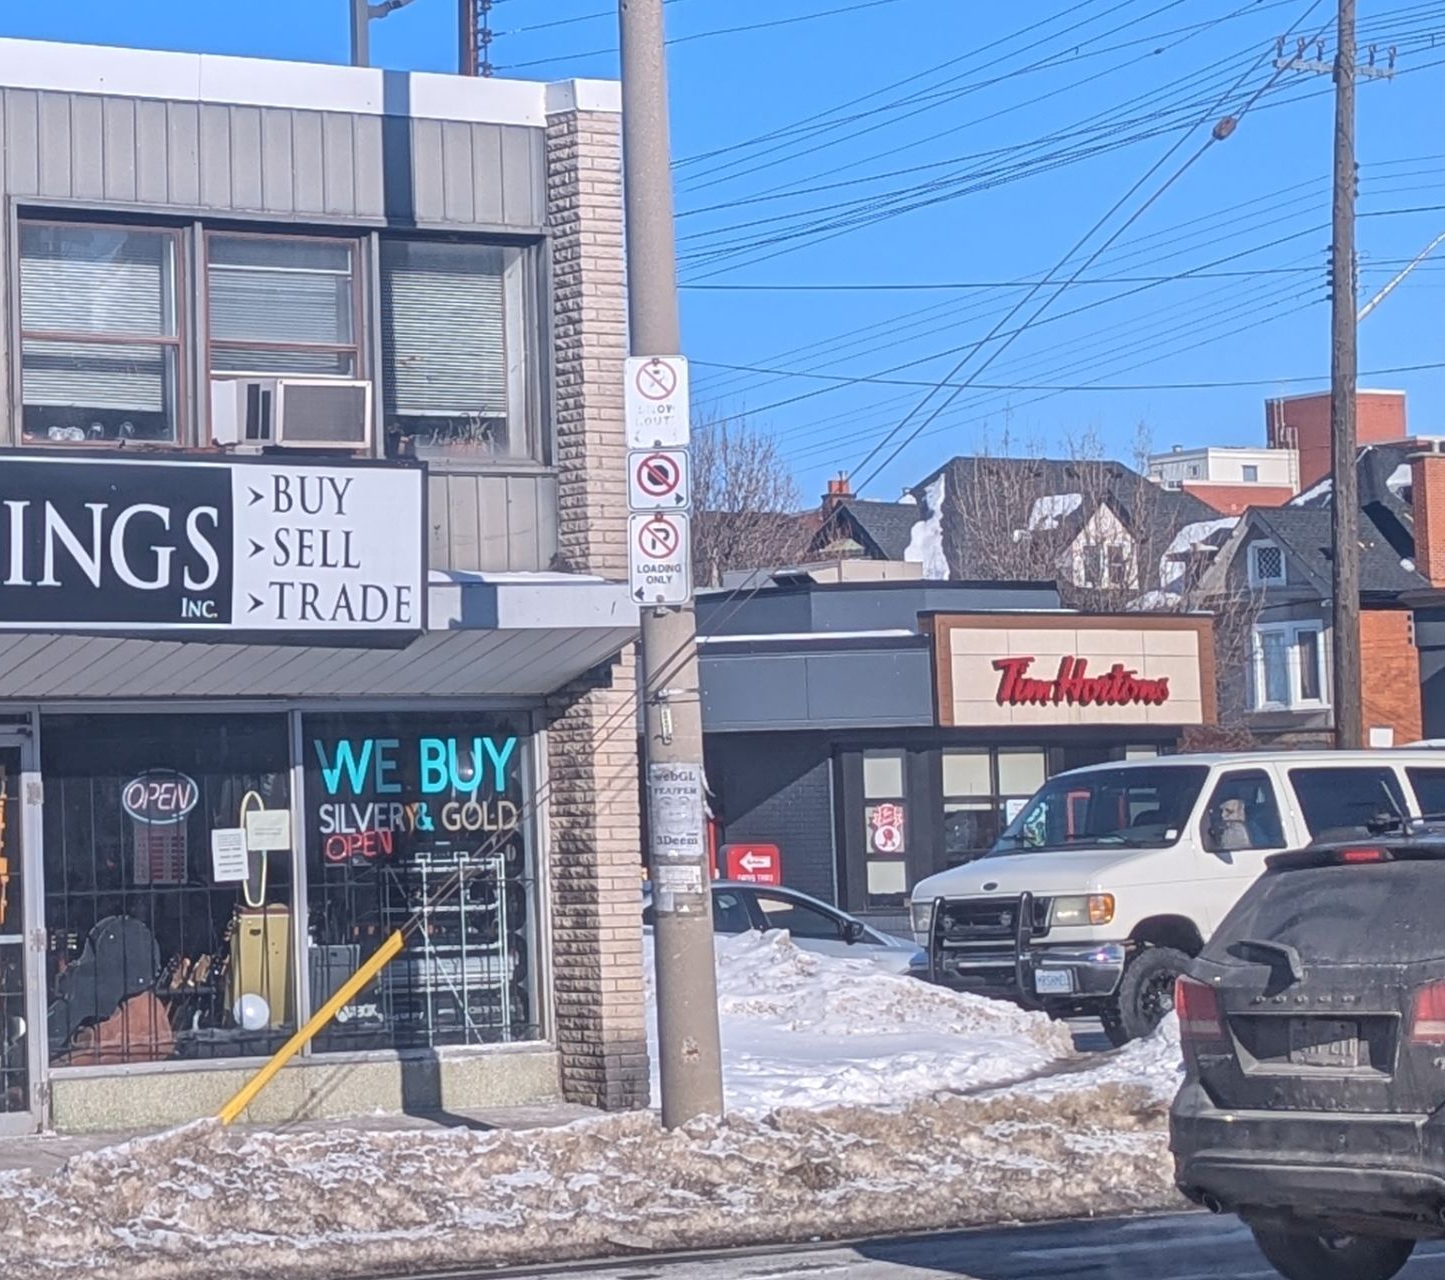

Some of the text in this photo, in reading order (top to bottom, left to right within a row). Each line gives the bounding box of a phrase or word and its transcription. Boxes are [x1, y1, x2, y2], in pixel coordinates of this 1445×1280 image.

[271, 474, 354, 515] BUY
[273, 527, 361, 569] SELL
[637, 564, 682, 574] LOADING
[646, 575, 673, 585] ONLY
[268, 581, 412, 623] TRADE
[992, 655, 1170, 707] Tim Hortons
[314, 737, 517, 794] WE BUY
[127, 783, 190, 810] OPEN
[442, 801, 518, 831] GOLD
[326, 829, 393, 860] OPEN
